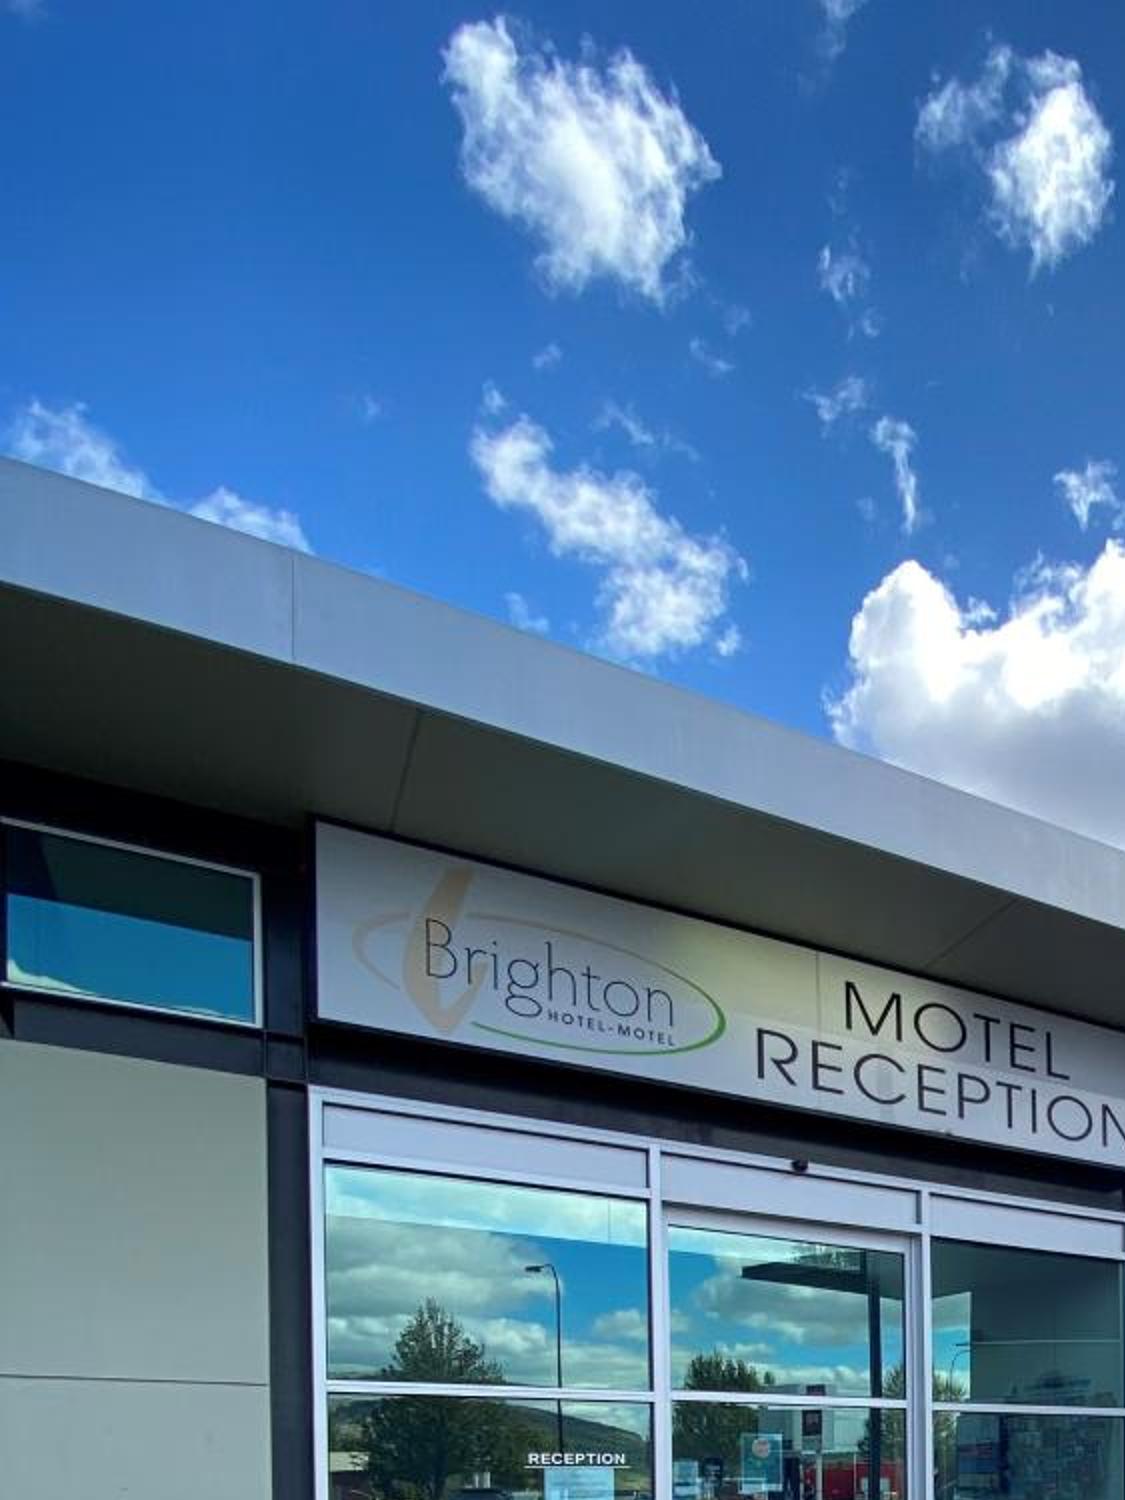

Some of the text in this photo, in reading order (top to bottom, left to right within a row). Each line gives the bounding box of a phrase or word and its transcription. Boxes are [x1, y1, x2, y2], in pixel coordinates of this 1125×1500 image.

[425, 917, 675, 1027] Brighton
[547, 1007, 676, 1047] HOTEL-MOTEL
[844, 979, 1071, 1081] MOTEL
[527, 1452, 626, 1466] RECEPTION
